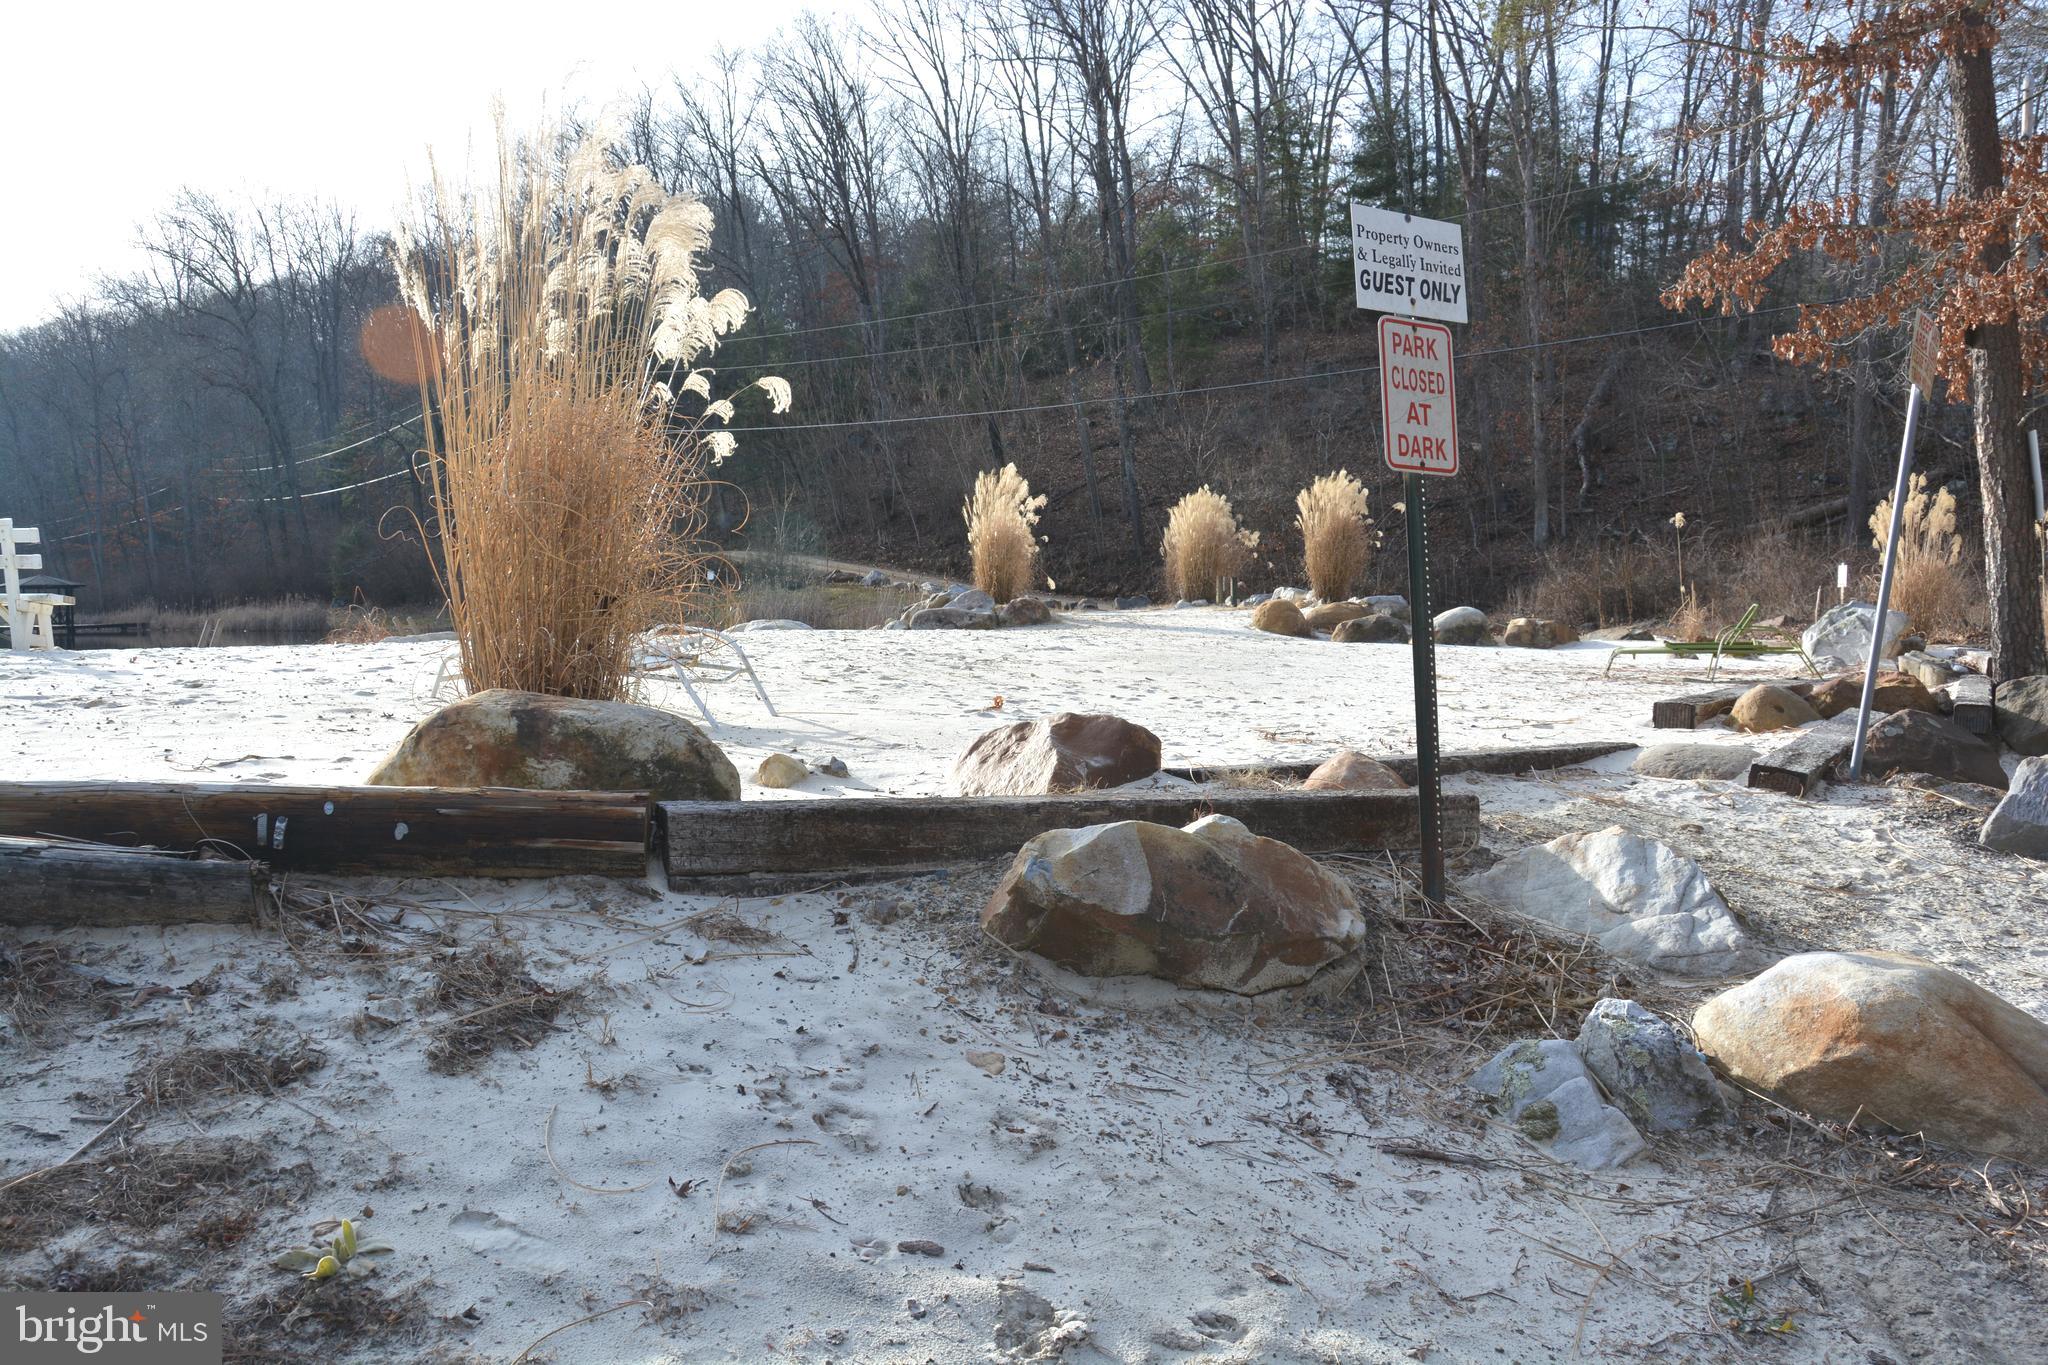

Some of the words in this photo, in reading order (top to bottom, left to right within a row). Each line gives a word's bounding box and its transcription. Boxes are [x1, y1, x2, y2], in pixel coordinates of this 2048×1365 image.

[1356, 224, 1410, 249] Property
[1413, 234, 1459, 255] Owners
[1357, 246, 1368, 262] &
[1371, 249, 1417, 272] Legally
[1420, 257, 1461, 277] Invited
[1360, 269, 1415, 297] GUEST
[1420, 279, 1461, 305] ONLY
[1392, 332, 1439, 361] PARK
[1391, 366, 1445, 395] CLOSED
[1406, 402, 1432, 427] AT
[1397, 433, 1448, 462] DARK
